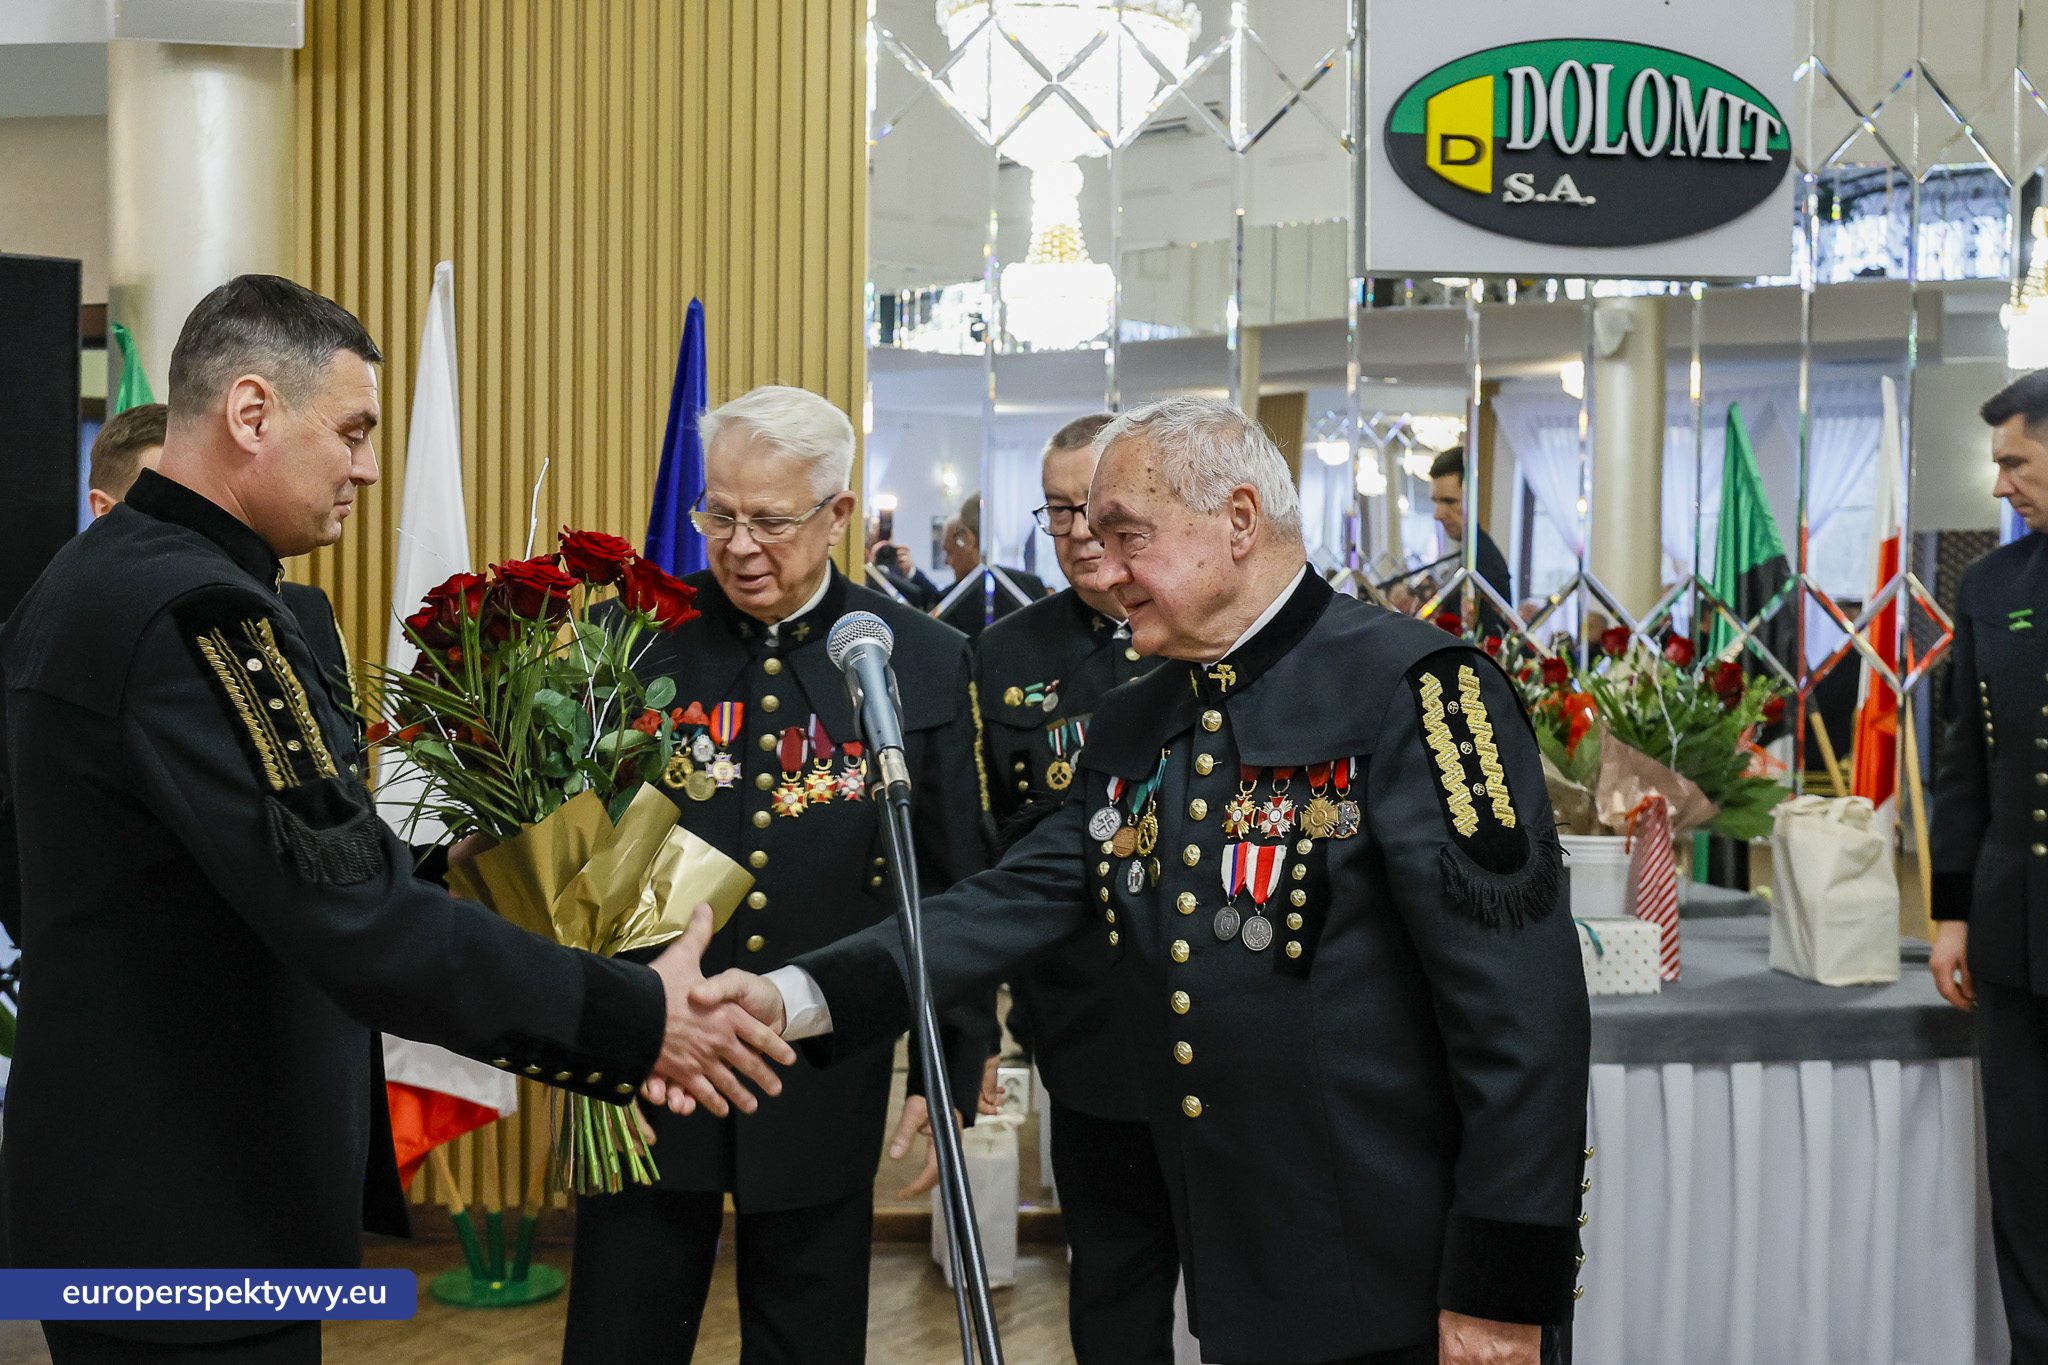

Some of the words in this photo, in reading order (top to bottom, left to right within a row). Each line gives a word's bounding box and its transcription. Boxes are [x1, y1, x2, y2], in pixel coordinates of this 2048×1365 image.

[1506, 59, 1782, 161] DOLOMIT
[1440, 134, 1482, 166] D
[1502, 172, 1597, 206] S.A.
